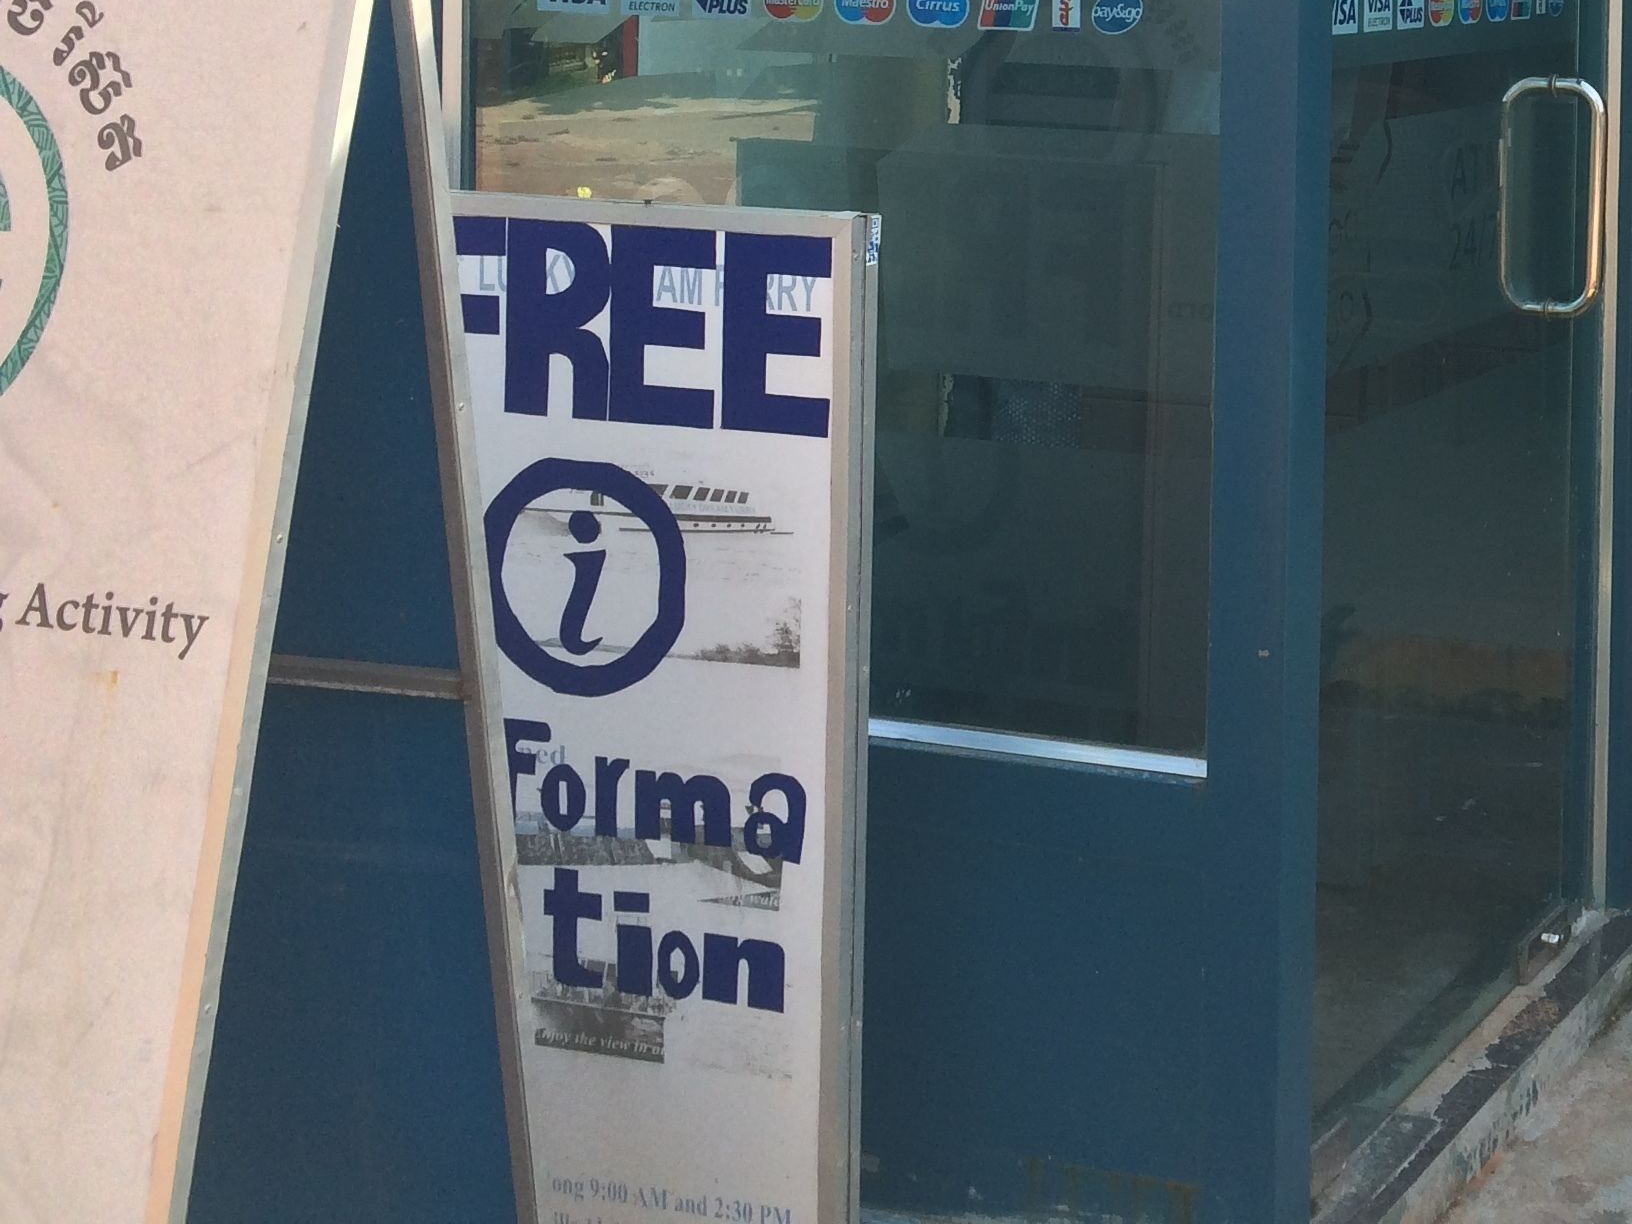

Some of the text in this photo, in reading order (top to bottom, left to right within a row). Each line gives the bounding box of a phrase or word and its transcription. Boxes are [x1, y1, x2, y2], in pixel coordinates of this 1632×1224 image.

[628, 1, 676, 12] ELECTRON
[1405, 7, 1423, 24] PLUS
[15, 582, 210, 660] Activity
[503, 717, 808, 865] Forma
[543, 867, 785, 1014] tion
[590, 1179, 629, 1204] 9:00
[635, 1187, 669, 1210] AM
[674, 1195, 708, 1217] and
[714, 1197, 753, 1222] 2:30
